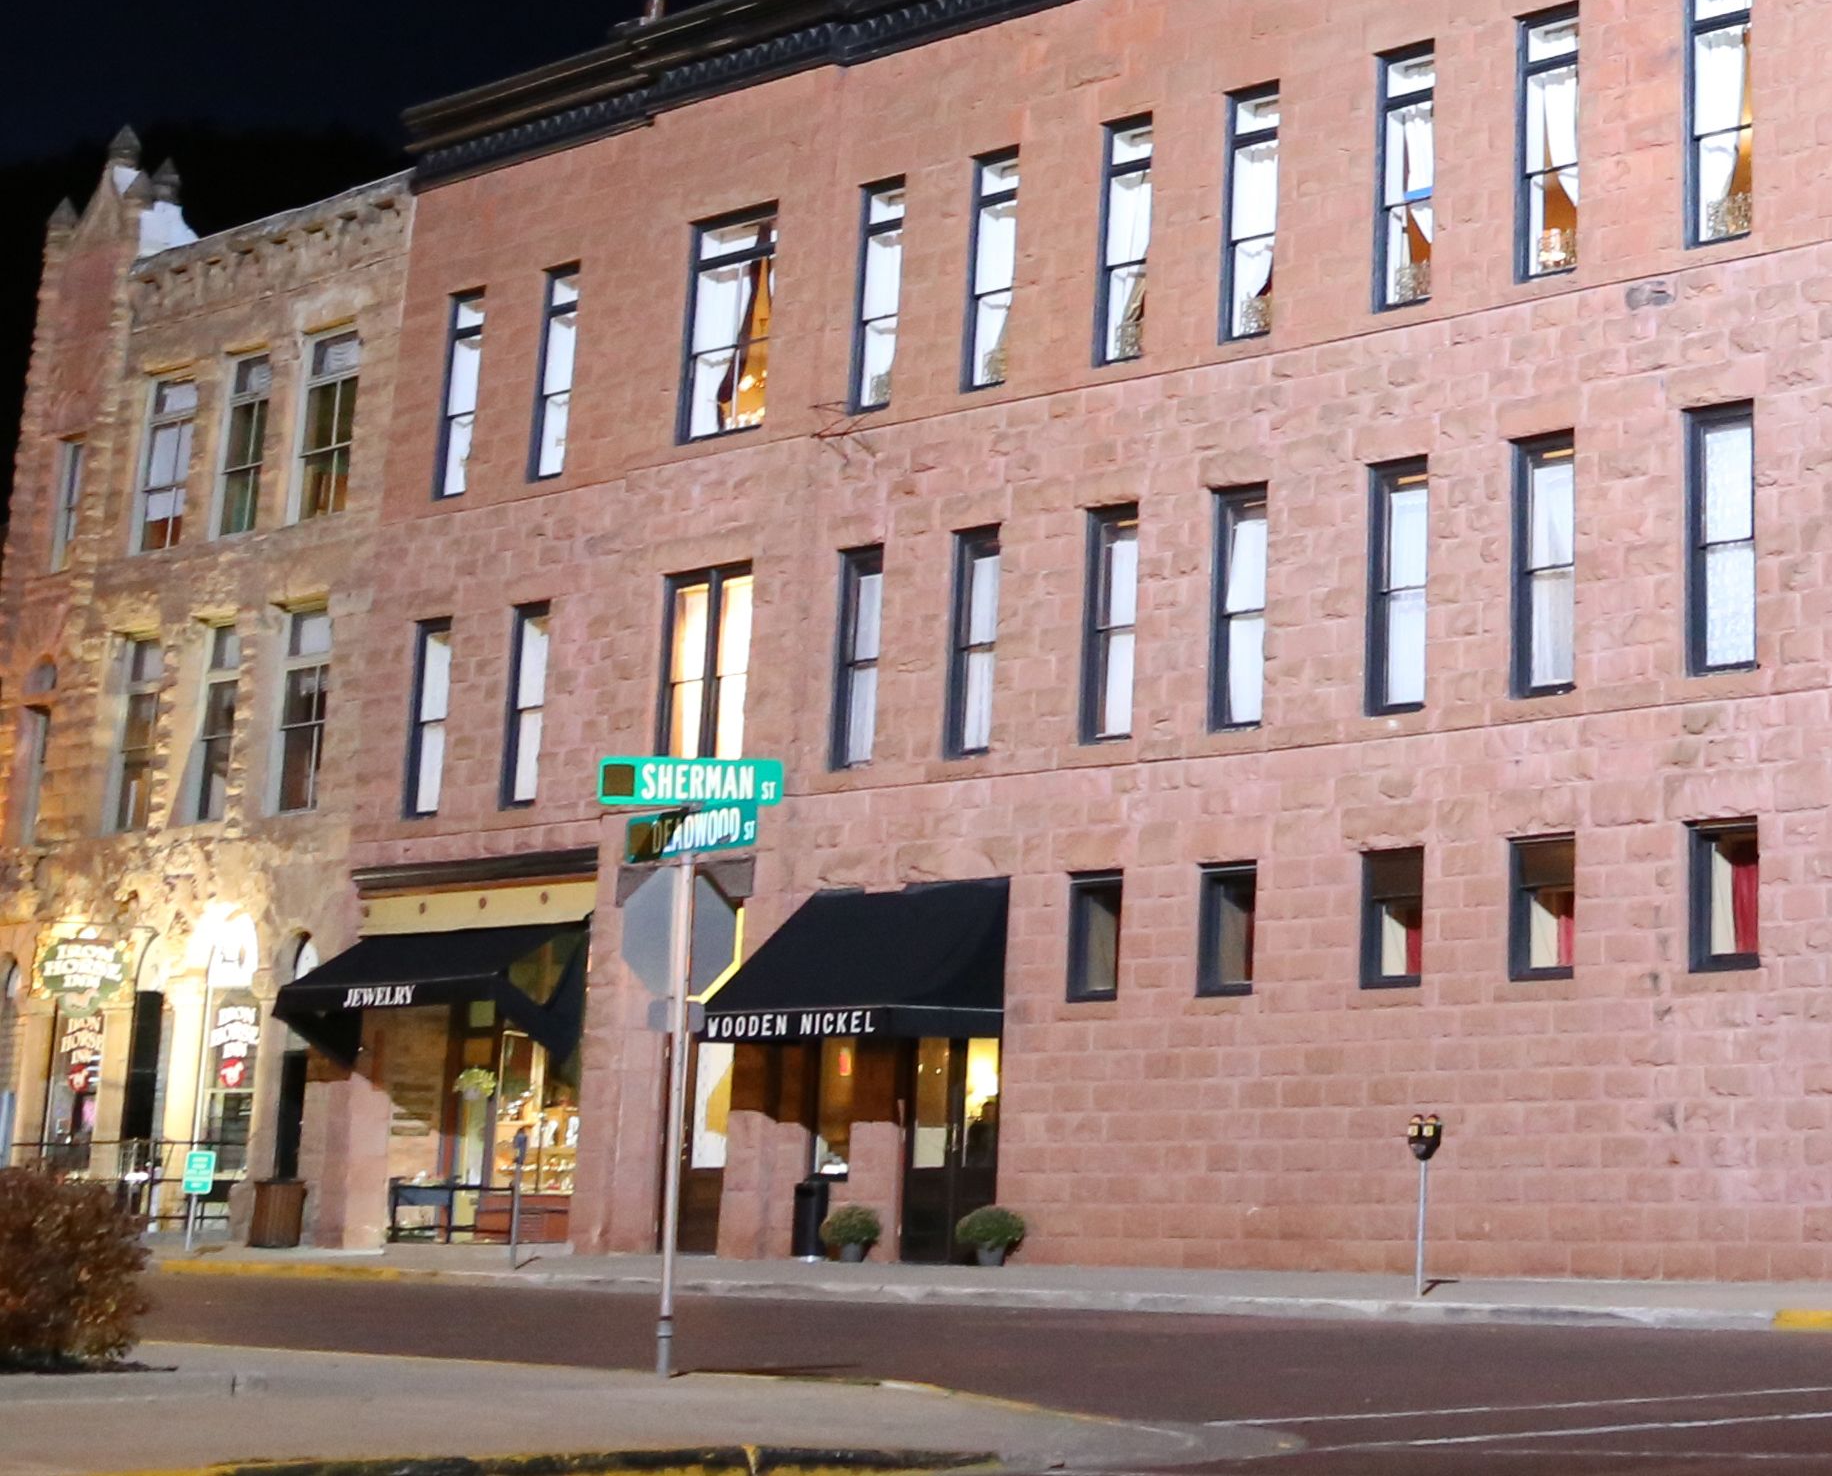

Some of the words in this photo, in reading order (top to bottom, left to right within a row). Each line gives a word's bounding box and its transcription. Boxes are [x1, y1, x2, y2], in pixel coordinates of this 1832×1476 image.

[640, 763, 755, 800] SHERMAN
[761, 781, 776, 799] ST
[652, 807, 741, 853] DEADWOOD
[744, 820, 755, 840] ST
[343, 985, 416, 1008] JEWELRY
[707, 1014, 788, 1038] WOODEN
[800, 1011, 876, 1035] NICKEL
